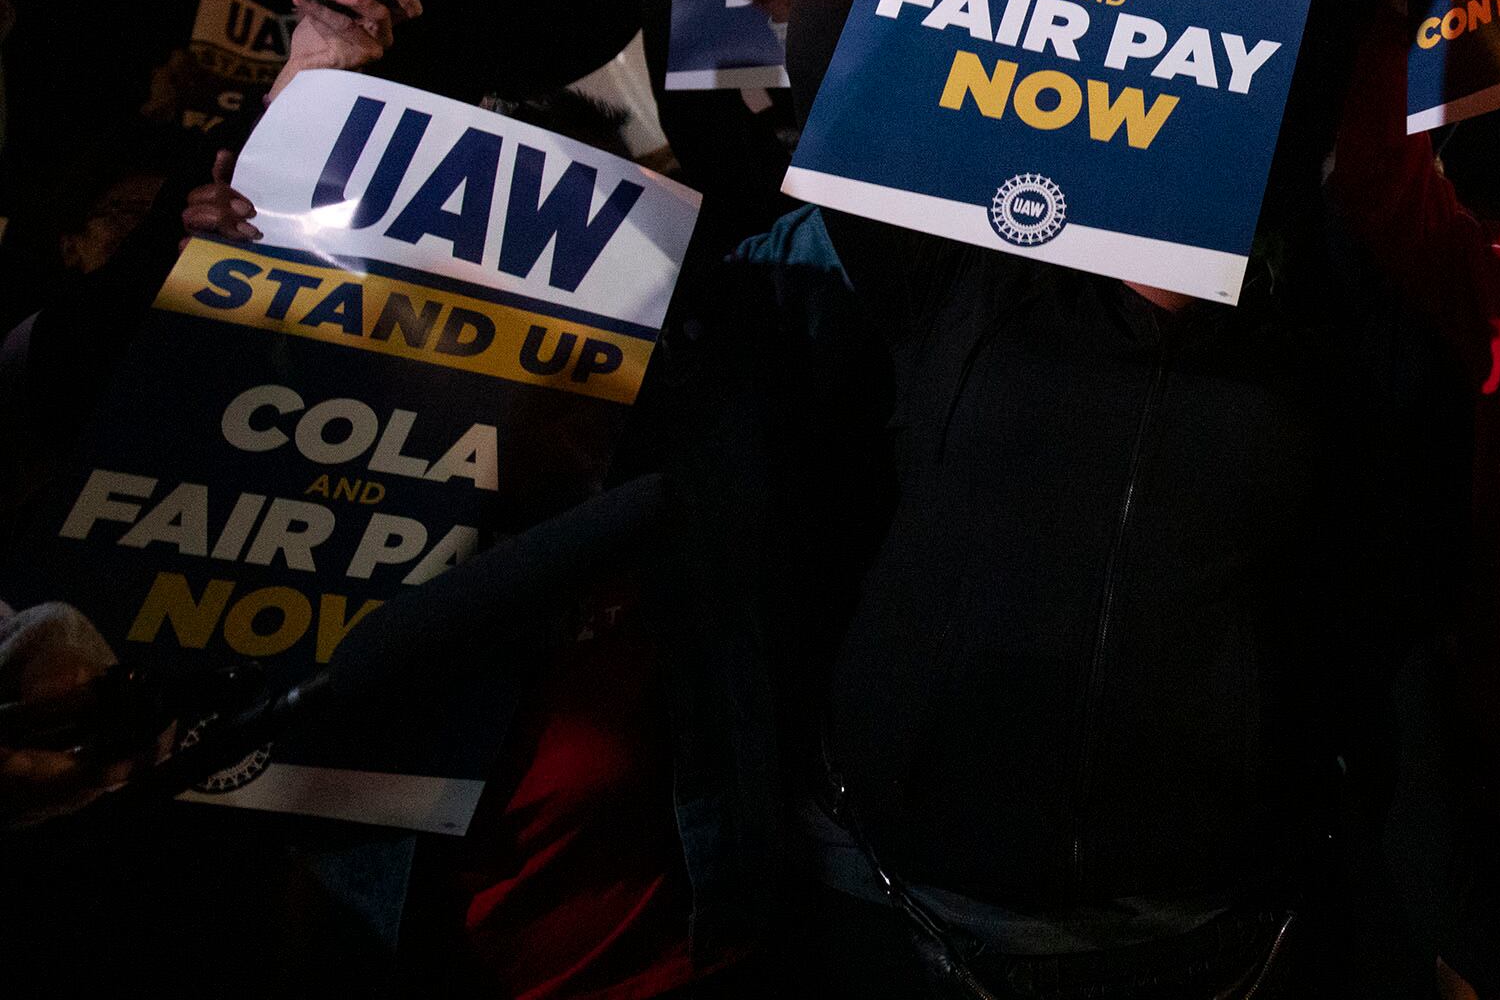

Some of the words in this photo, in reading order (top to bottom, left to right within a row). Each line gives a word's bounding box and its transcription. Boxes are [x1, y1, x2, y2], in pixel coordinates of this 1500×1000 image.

[226, 1, 297, 55] UA
[1103, 12, 1282, 94] PAY
[939, 50, 1181, 150] NOW
[311, 96, 644, 293] UAW
[1013, 197, 1046, 218] UAW
[193, 259, 496, 358] STAND
[518, 328, 624, 383] UP
[221, 384, 499, 492] COLA
[58, 470, 336, 574] FAIR
[345, 512, 480, 586] PA
[304, 474, 387, 506] AND
